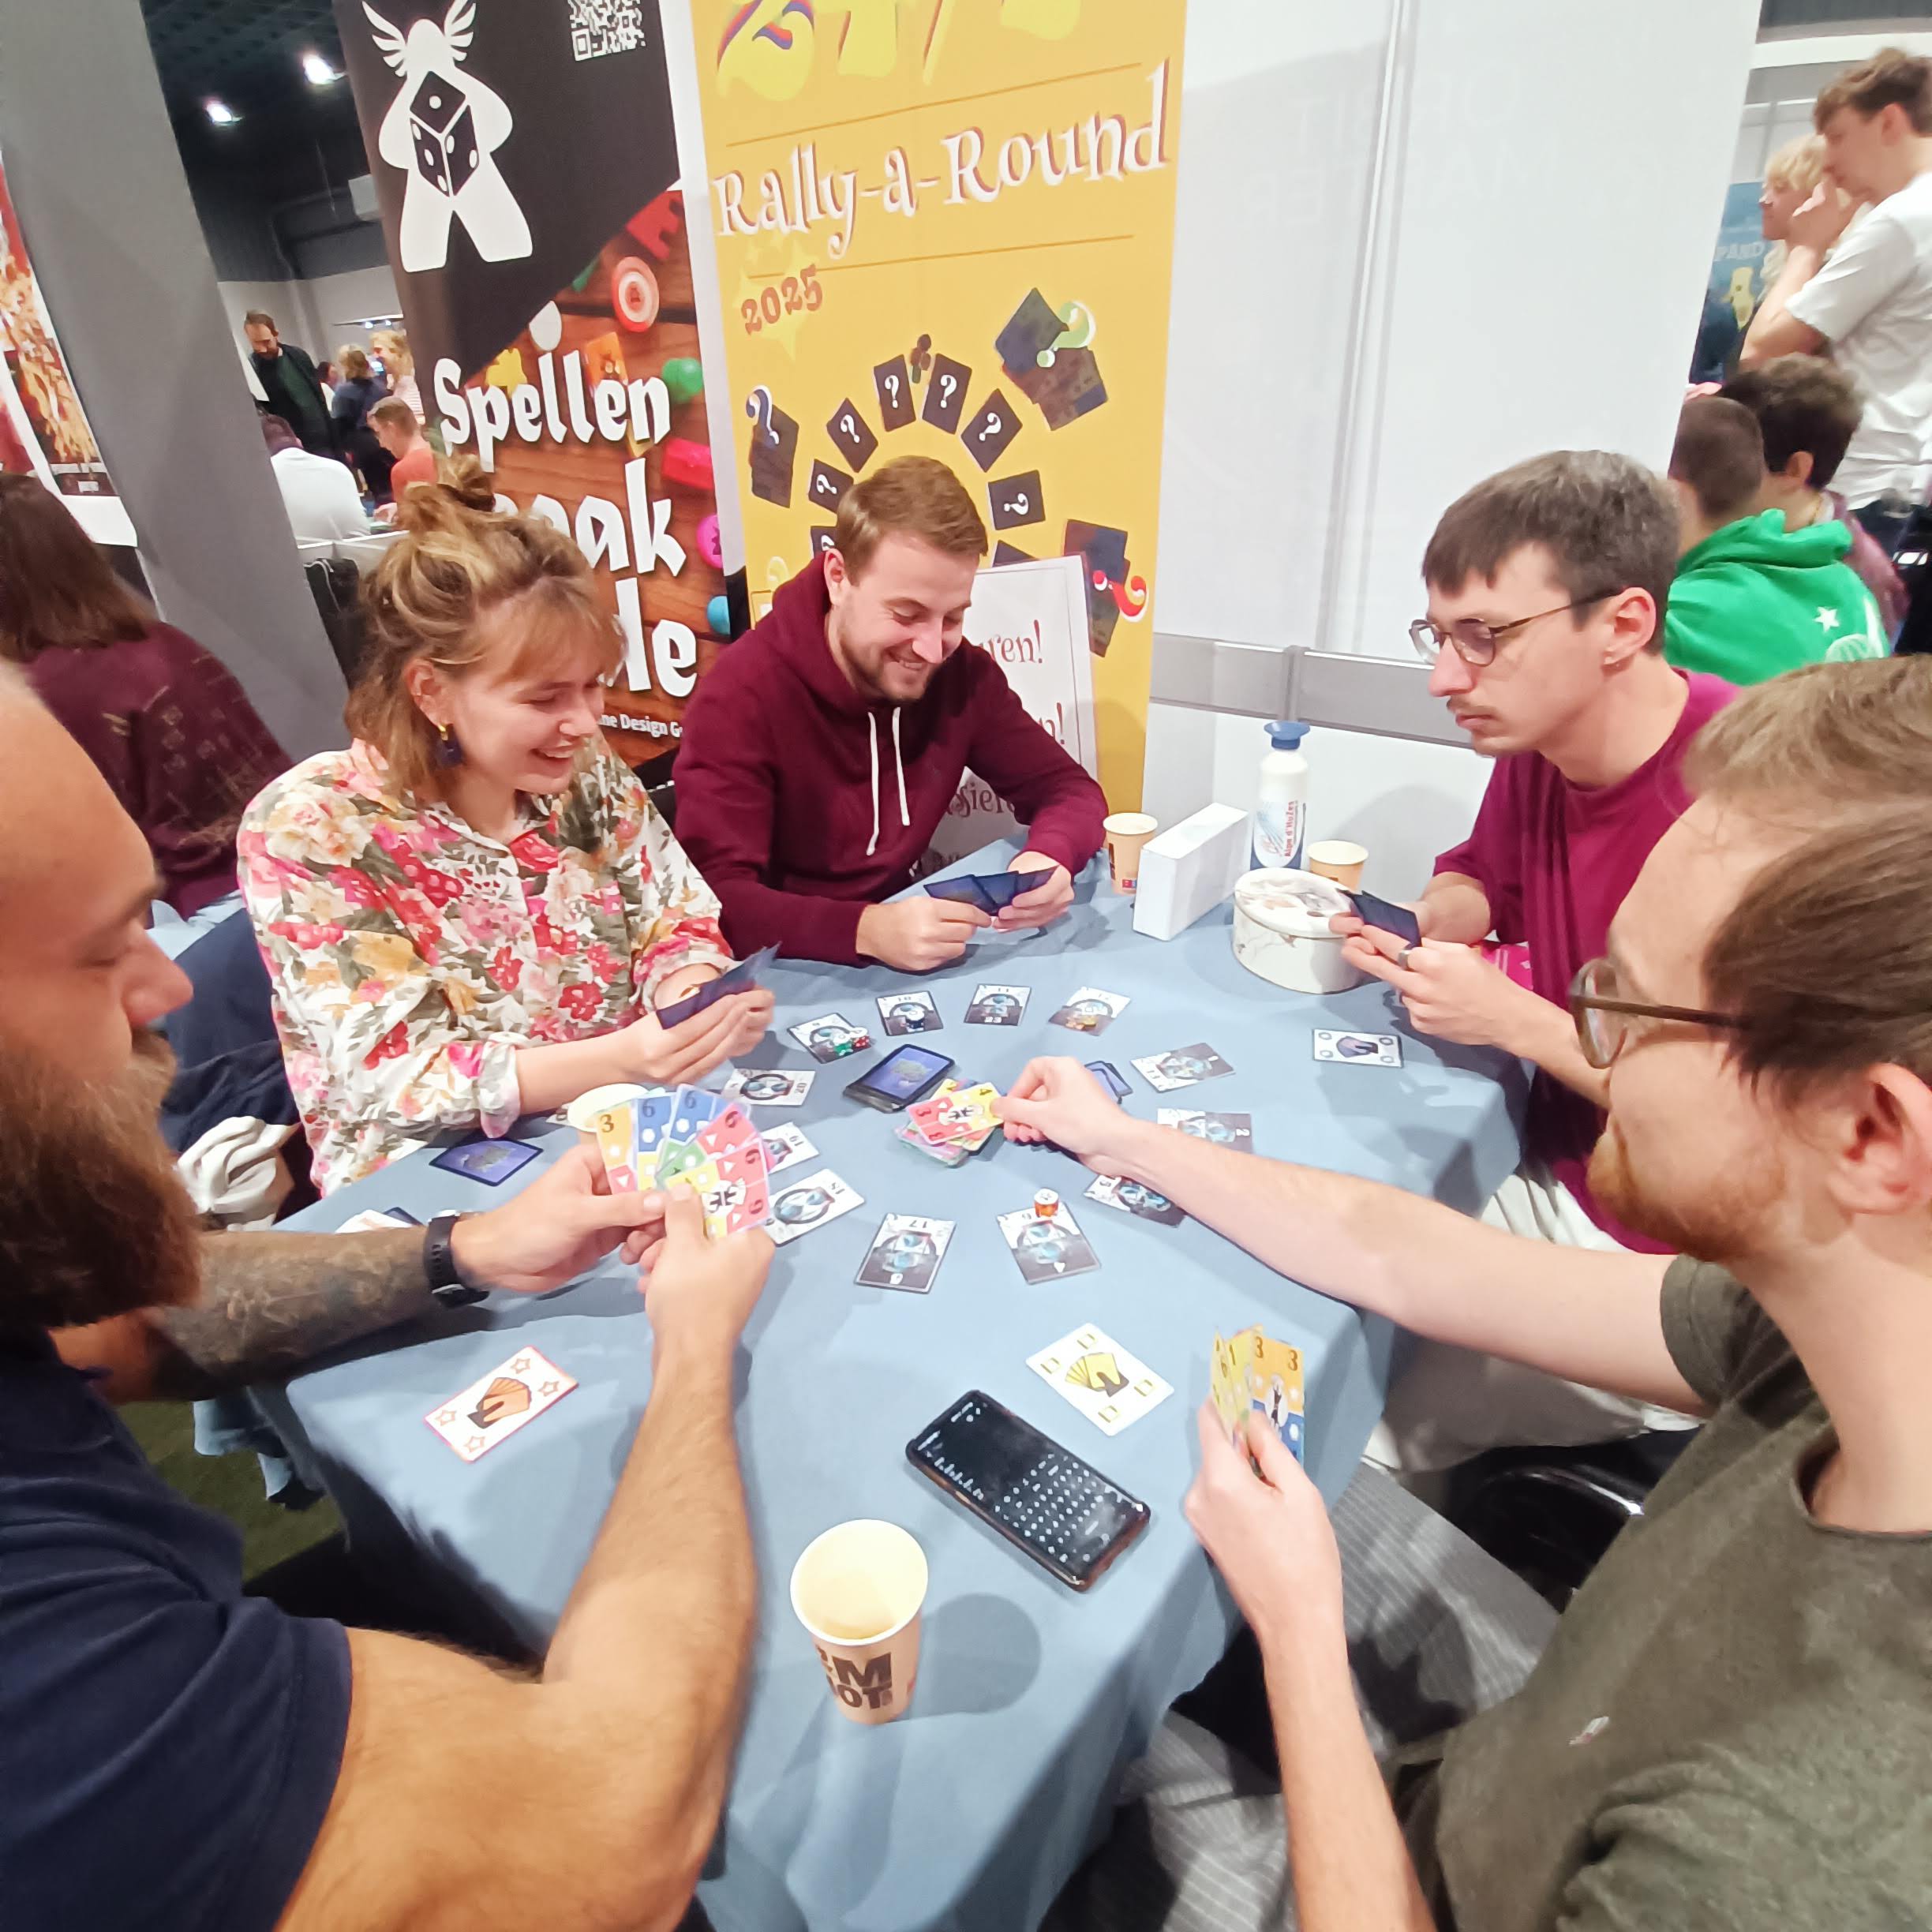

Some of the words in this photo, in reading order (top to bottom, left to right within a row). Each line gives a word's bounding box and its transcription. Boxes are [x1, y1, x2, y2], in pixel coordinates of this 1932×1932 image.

[712, 58, 1170, 257] Rally-a-Round
[741, 264, 823, 335] 2025
[433, 352, 671, 473] Spellen
[619, 713, 668, 738] Design
[642, 1099, 656, 1118] 6
[684, 1091, 696, 1110] 6
[600, 1114, 615, 1133] 3
[1256, 1335, 1264, 1359] 3
[1288, 1350, 1298, 1372] 3
